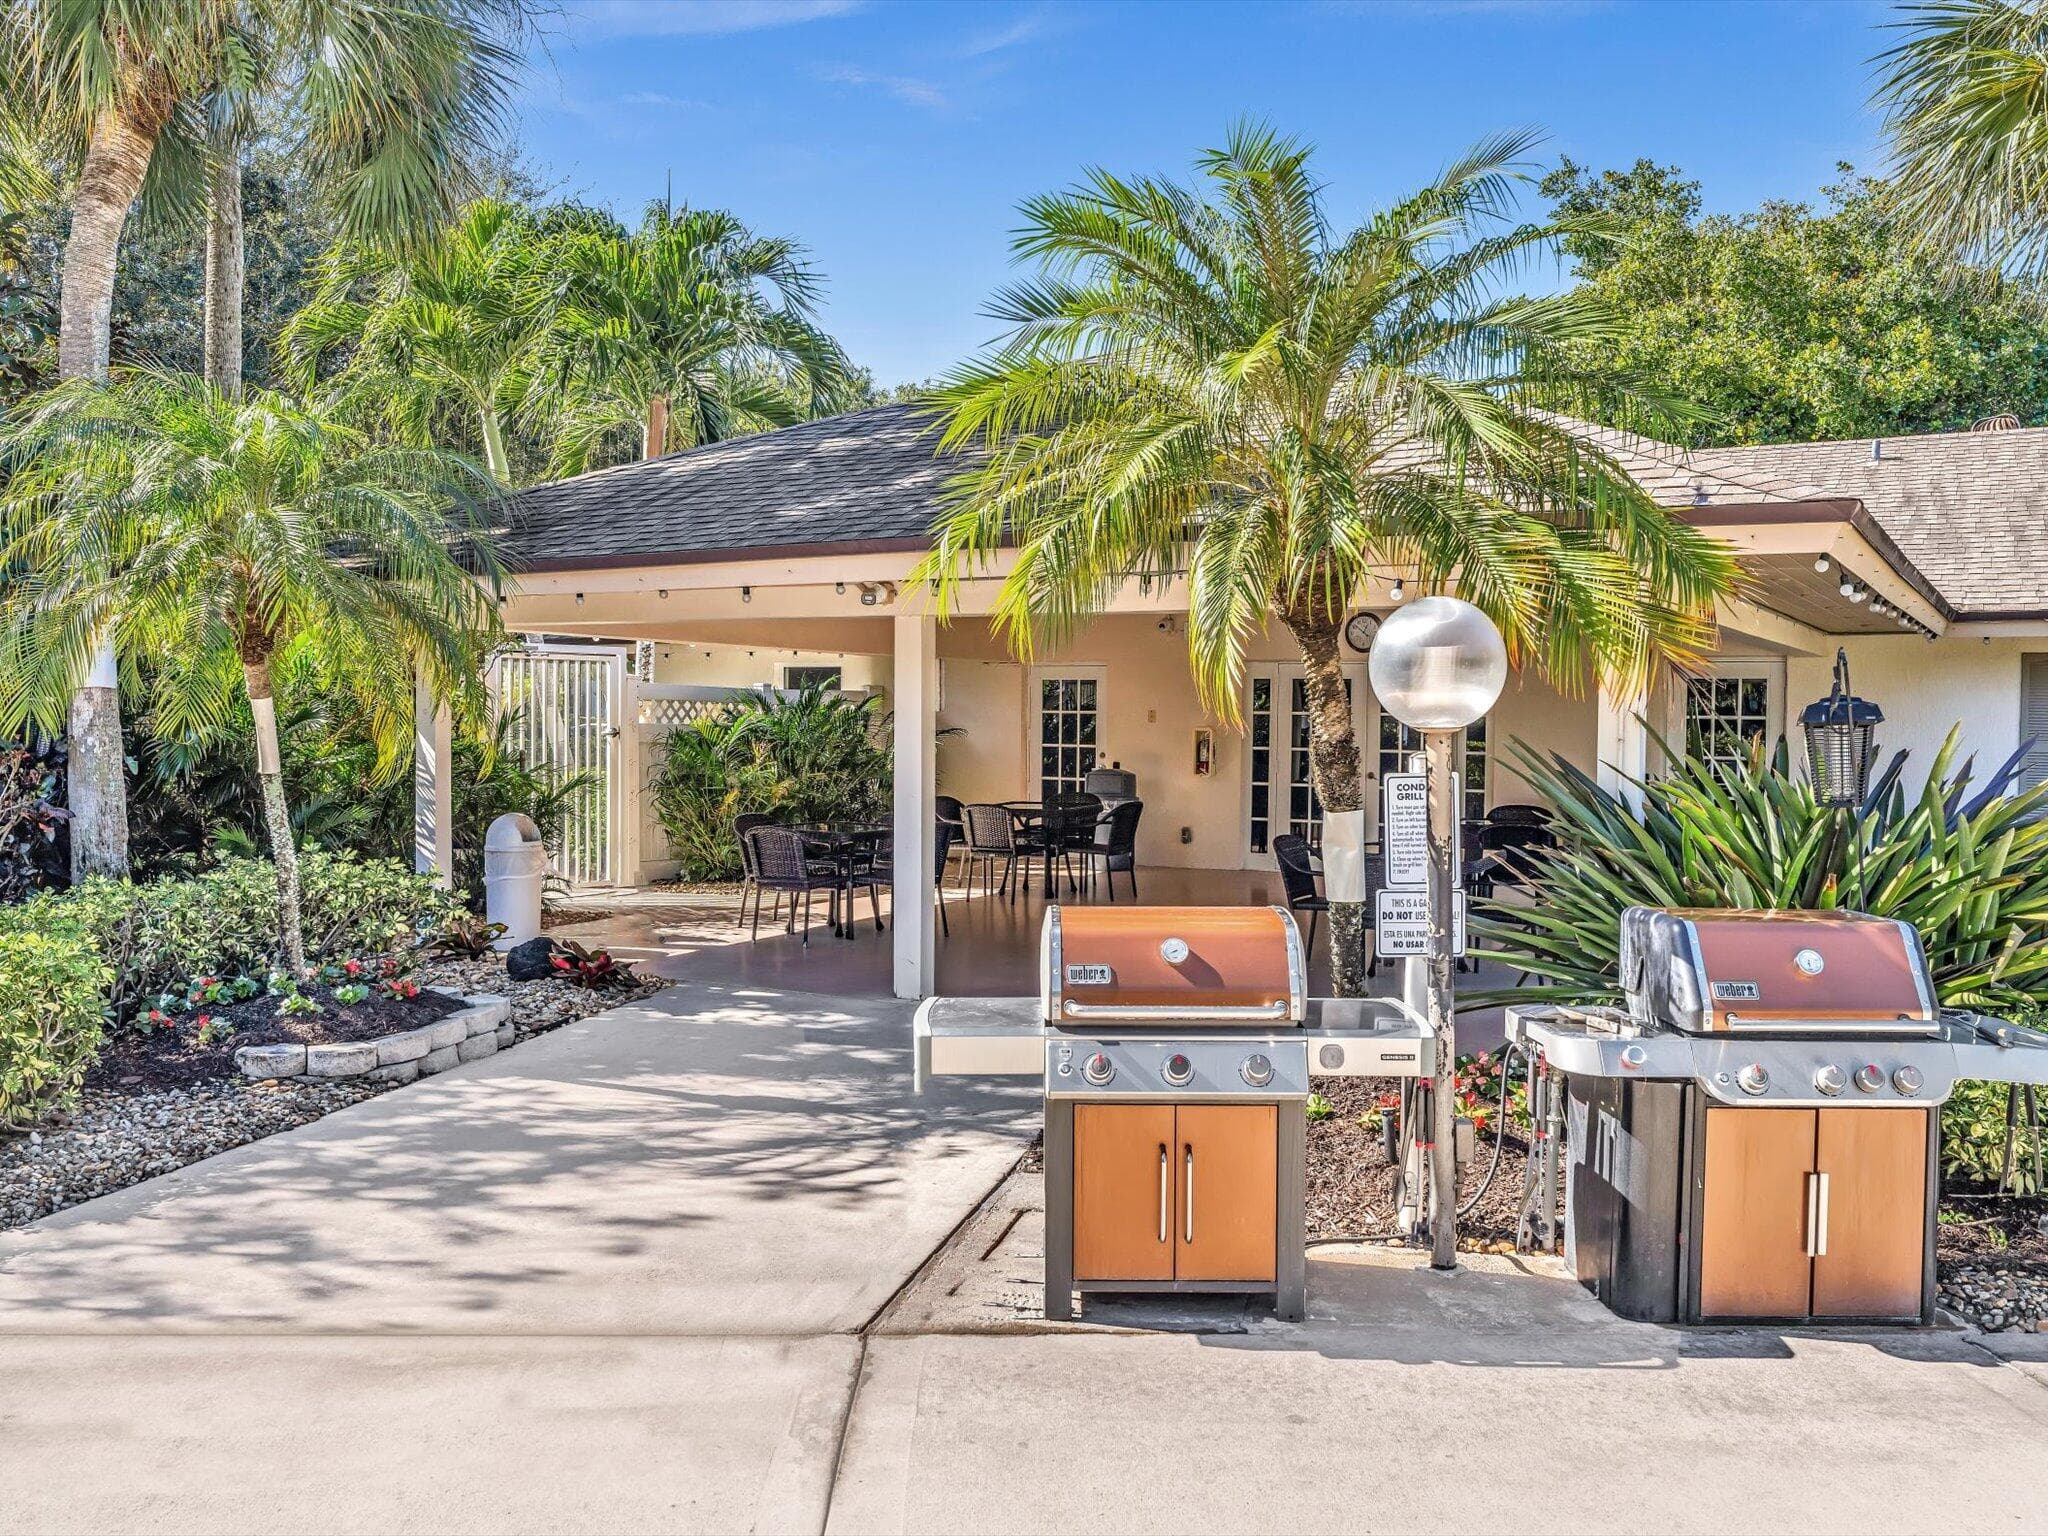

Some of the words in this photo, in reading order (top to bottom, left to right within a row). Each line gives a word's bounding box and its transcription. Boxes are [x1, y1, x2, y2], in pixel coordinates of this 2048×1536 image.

[1396, 783, 1425, 792] COND
[1396, 792, 1424, 801] GRILL
[1391, 898, 1405, 908] THIS
[1406, 898, 1412, 908] IS
[1413, 898, 1417, 908] A
[1419, 898, 1427, 908] GA
[1382, 911, 1394, 920] DO
[1396, 911, 1413, 920] NOT
[1415, 910, 1427, 920] USE
[1383, 930, 1395, 939] ESTA
[1392, 940, 1404, 949] NO
[1405, 940, 1425, 949] USAR
[1070, 965, 1099, 980] weber
[1716, 982, 1747, 997] weber
